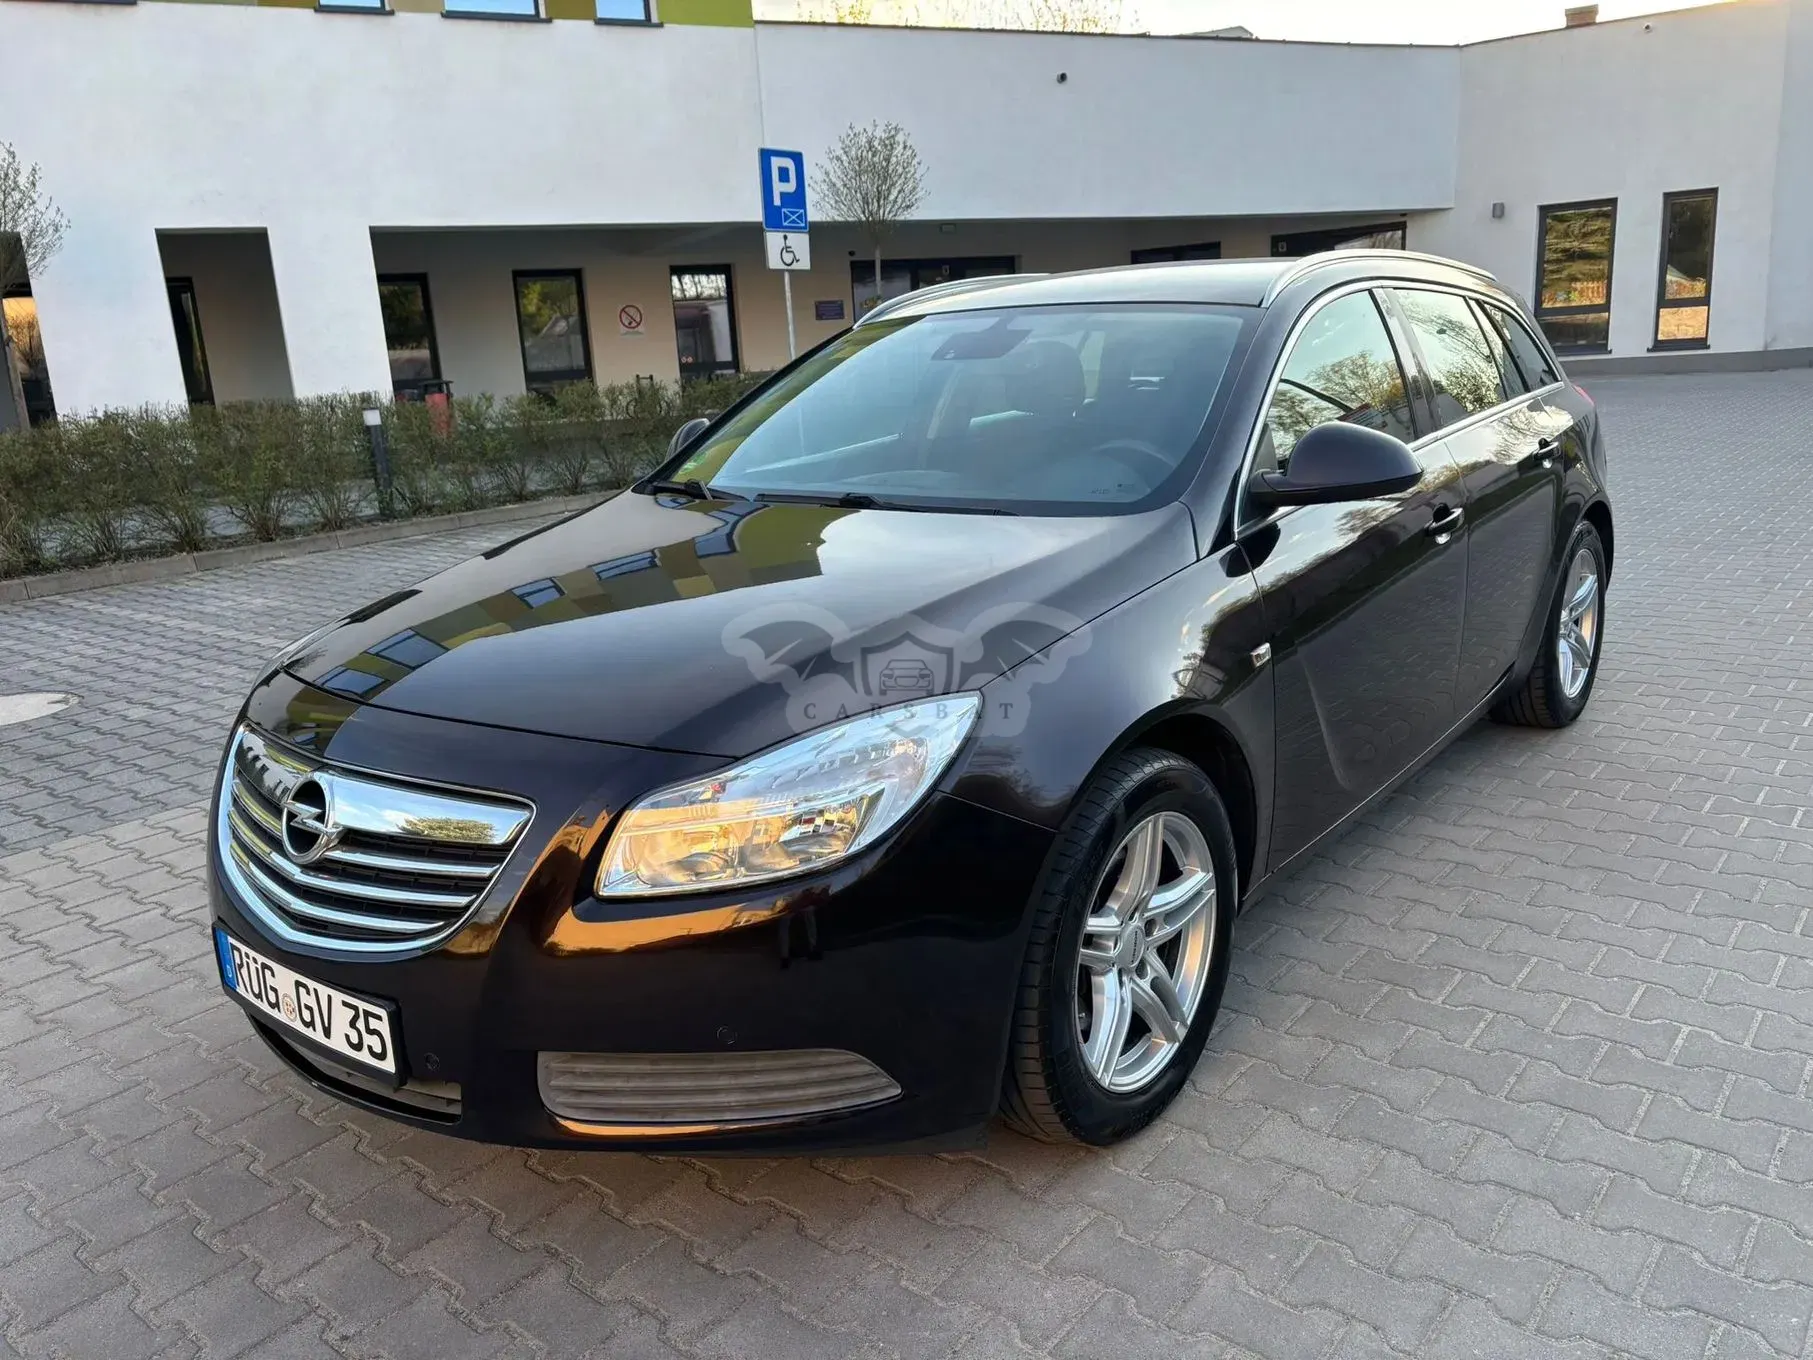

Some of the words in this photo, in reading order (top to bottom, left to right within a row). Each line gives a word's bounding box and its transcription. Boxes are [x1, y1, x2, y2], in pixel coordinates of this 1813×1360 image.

[770, 156, 797, 207] P
[230, 943, 281, 1013] RÜG
[294, 979, 332, 1040] GV
[341, 999, 387, 1061] 35
